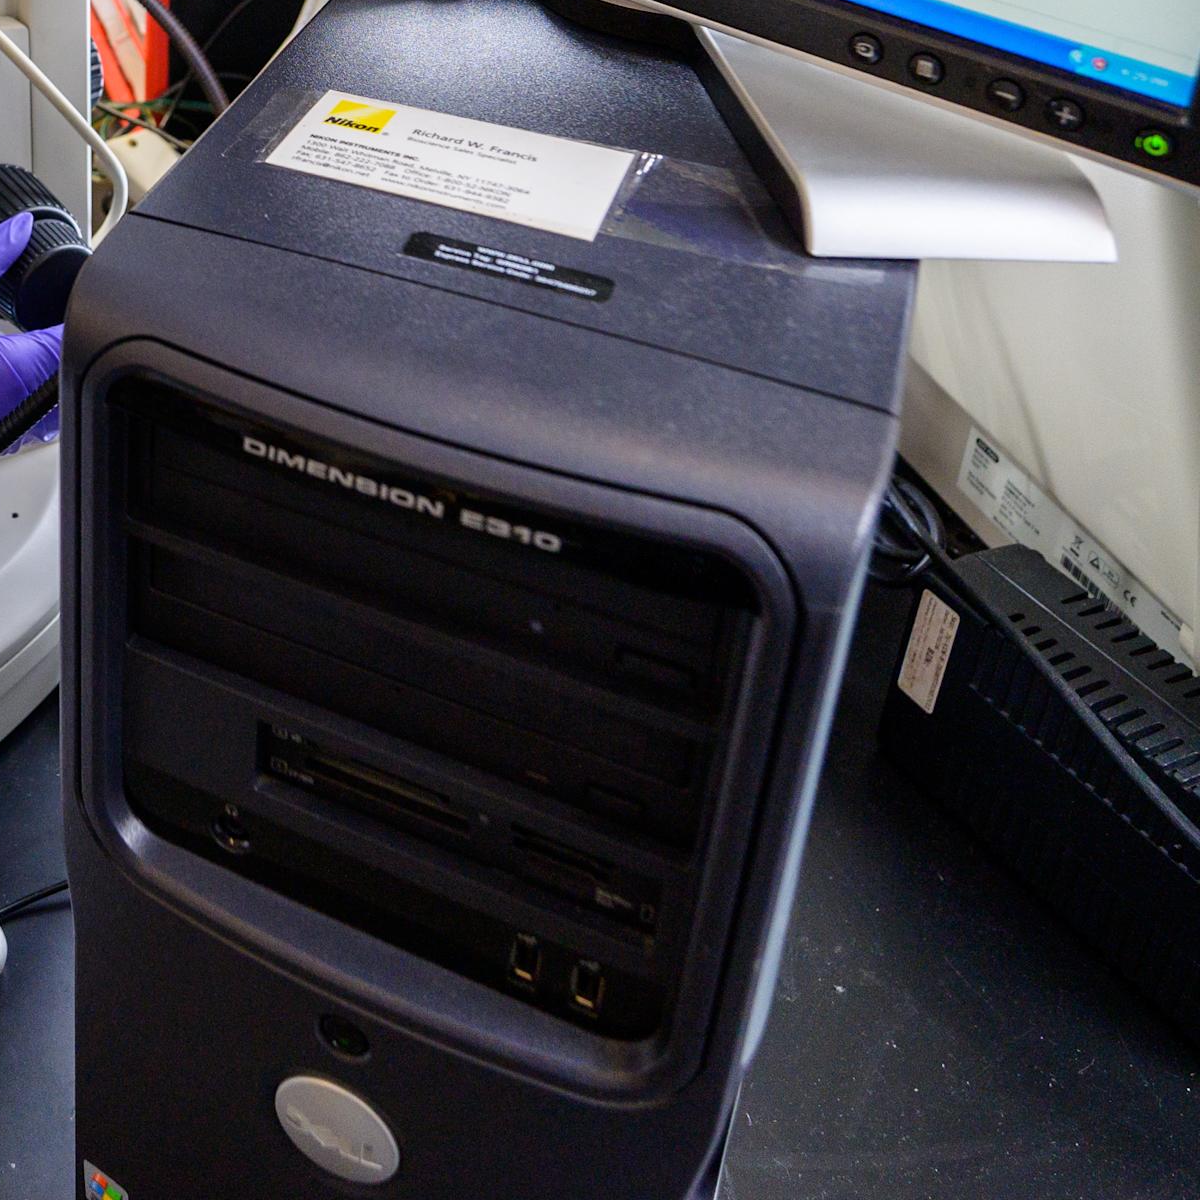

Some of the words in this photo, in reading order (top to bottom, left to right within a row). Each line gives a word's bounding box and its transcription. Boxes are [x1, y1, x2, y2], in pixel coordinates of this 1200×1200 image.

[323, 115, 380, 133] Nikon
[309, 133, 337, 142] NIKON
[338, 140, 401, 157] INSTRUMENTS
[411, 128, 464, 144] Richard
[465, 140, 486, 150] W.
[488, 146, 539, 162] Francis
[242, 435, 445, 519] DIMENSION
[460, 508, 563, 554] E310
